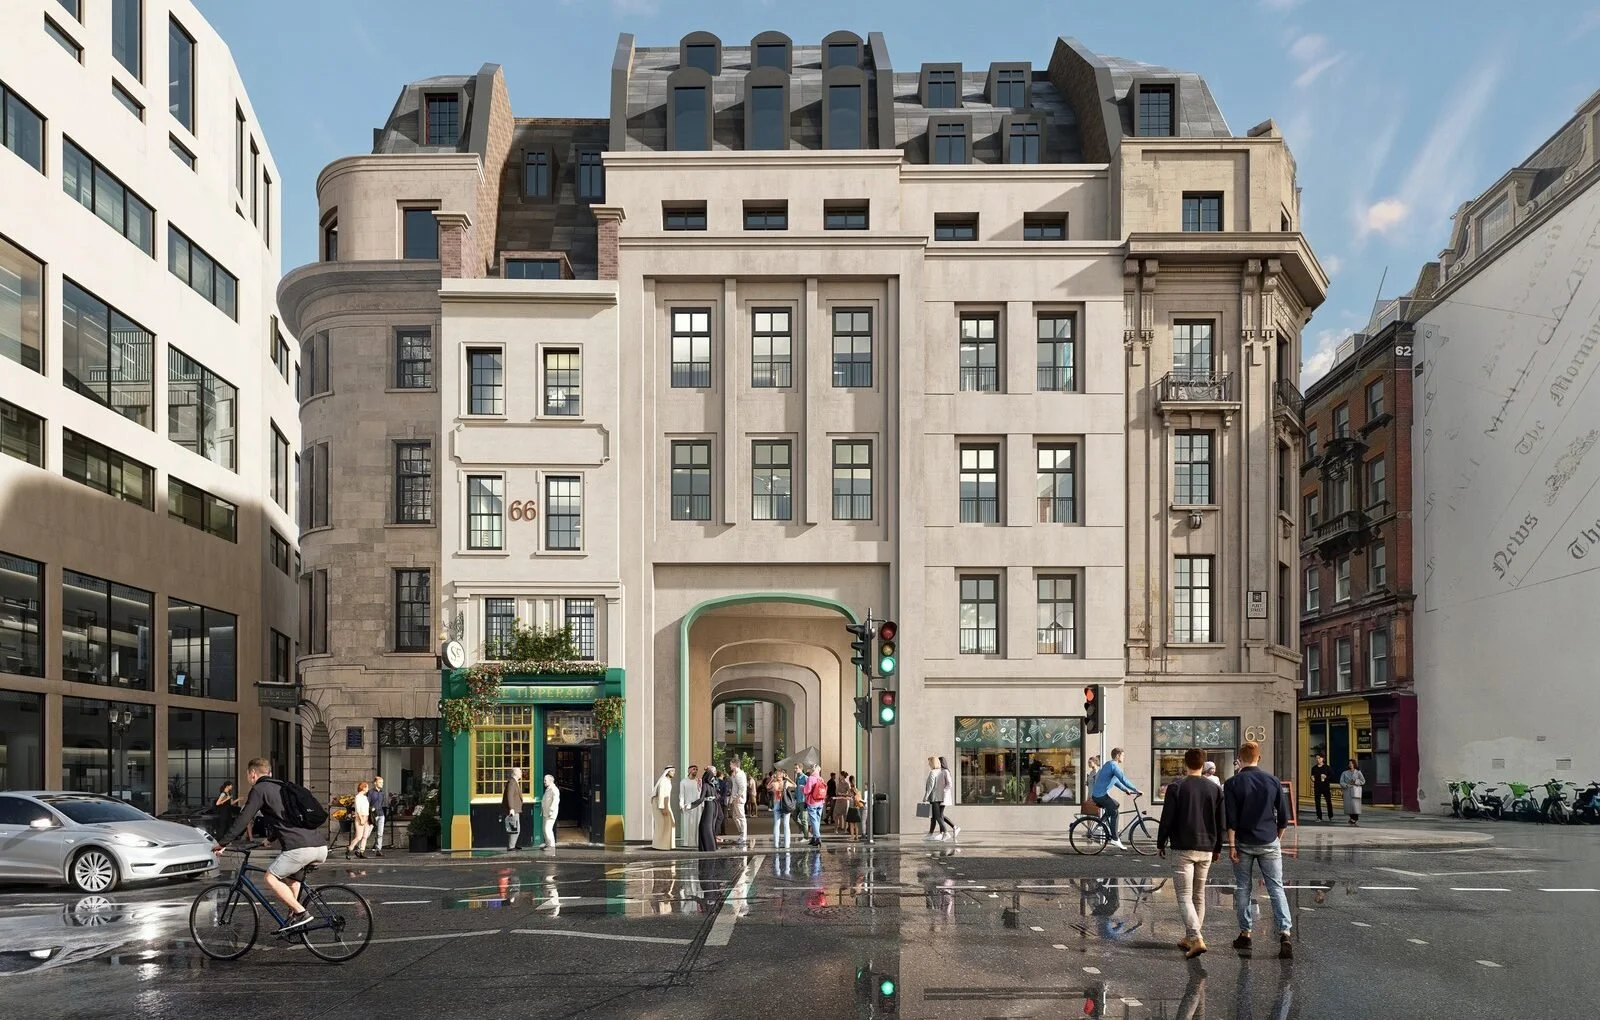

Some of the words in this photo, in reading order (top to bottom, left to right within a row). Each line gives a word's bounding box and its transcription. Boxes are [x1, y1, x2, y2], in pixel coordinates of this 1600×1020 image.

[1395, 345, 1412, 357] 62
[1514, 420, 1545, 456] The
[1550, 314, 1600, 407] Mornin
[509, 500, 537, 521] 66
[1492, 511, 1538, 580] News
[517, 687, 594, 698] TIPPERARY
[1244, 725, 1266, 742] 63
